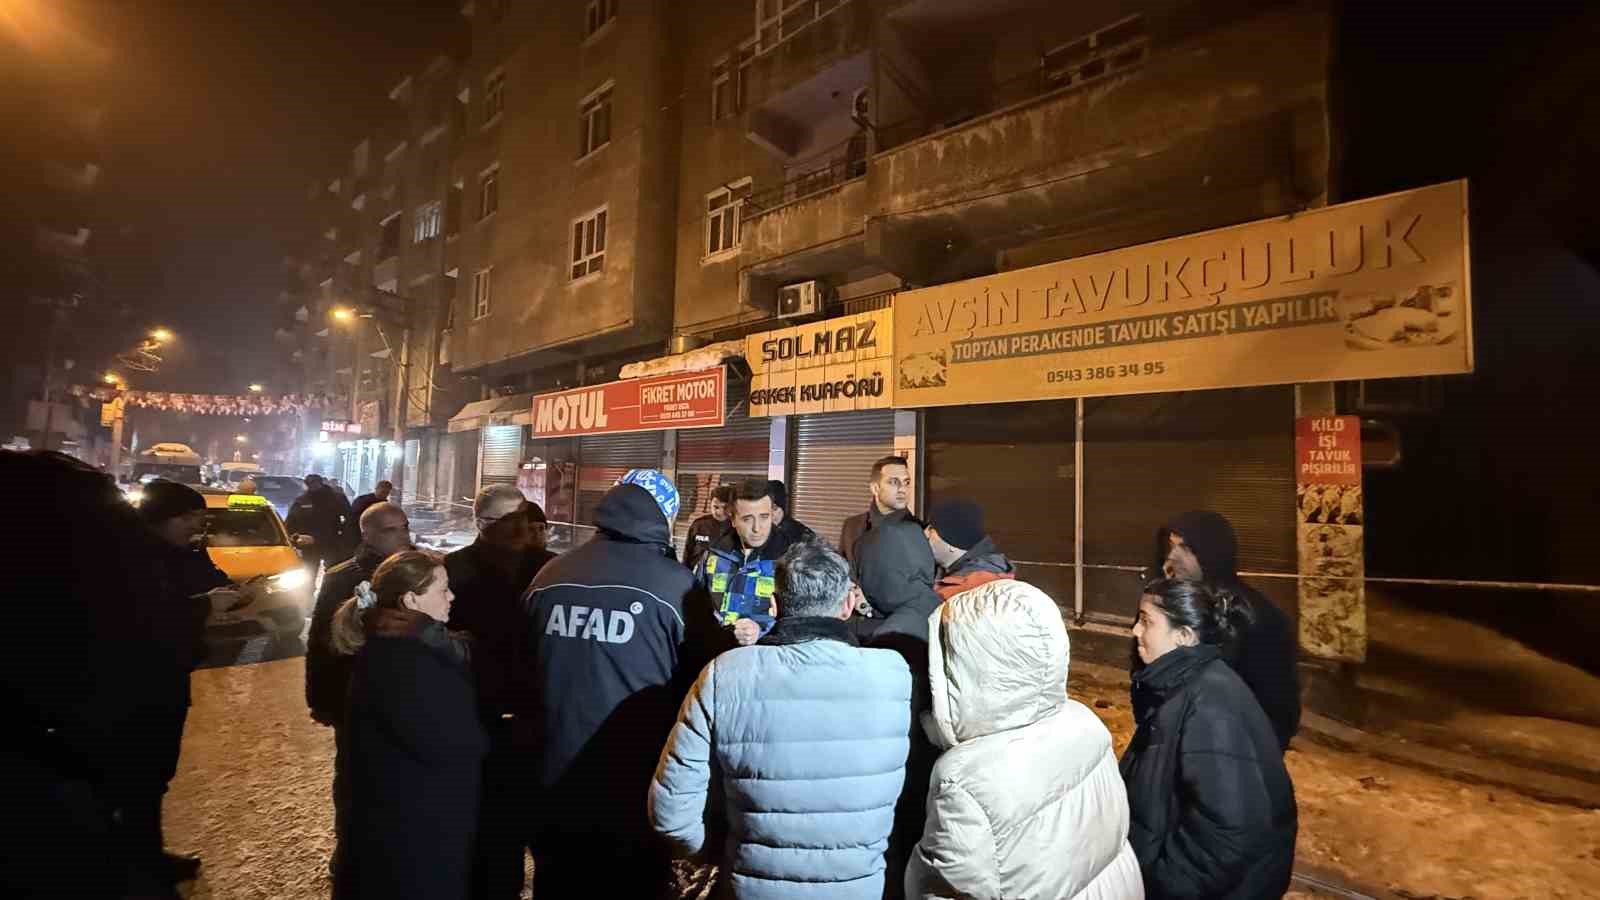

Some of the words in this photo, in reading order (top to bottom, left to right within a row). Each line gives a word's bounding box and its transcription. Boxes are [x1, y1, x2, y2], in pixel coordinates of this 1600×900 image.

[912, 286, 1023, 338] AVŞİN
[1033, 213, 1427, 320] TAVUKÇULUK
[761, 320, 877, 362] SOLMAZ
[956, 340, 1008, 361] TOPTAN
[1012, 326, 1105, 353] PERAKENDE
[1108, 320, 1168, 344] TAVUK
[1172, 310, 1236, 335] SATIŞI
[1241, 296, 1336, 328] YAPILIR
[677, 379, 716, 403] MOTOR
[750, 386, 796, 405] ERKEK
[800, 371, 885, 401] KUAFÖRÜ
[1047, 368, 1082, 384] 0543
[1086, 366, 1115, 381] 386
[1118, 364, 1139, 378] 34
[1143, 361, 1165, 376] 95
[535, 390, 608, 433] MOTUL
[1311, 416, 1344, 432] KİLO
[1309, 450, 1351, 461] TAVUK
[545, 604, 635, 644] AFAD
